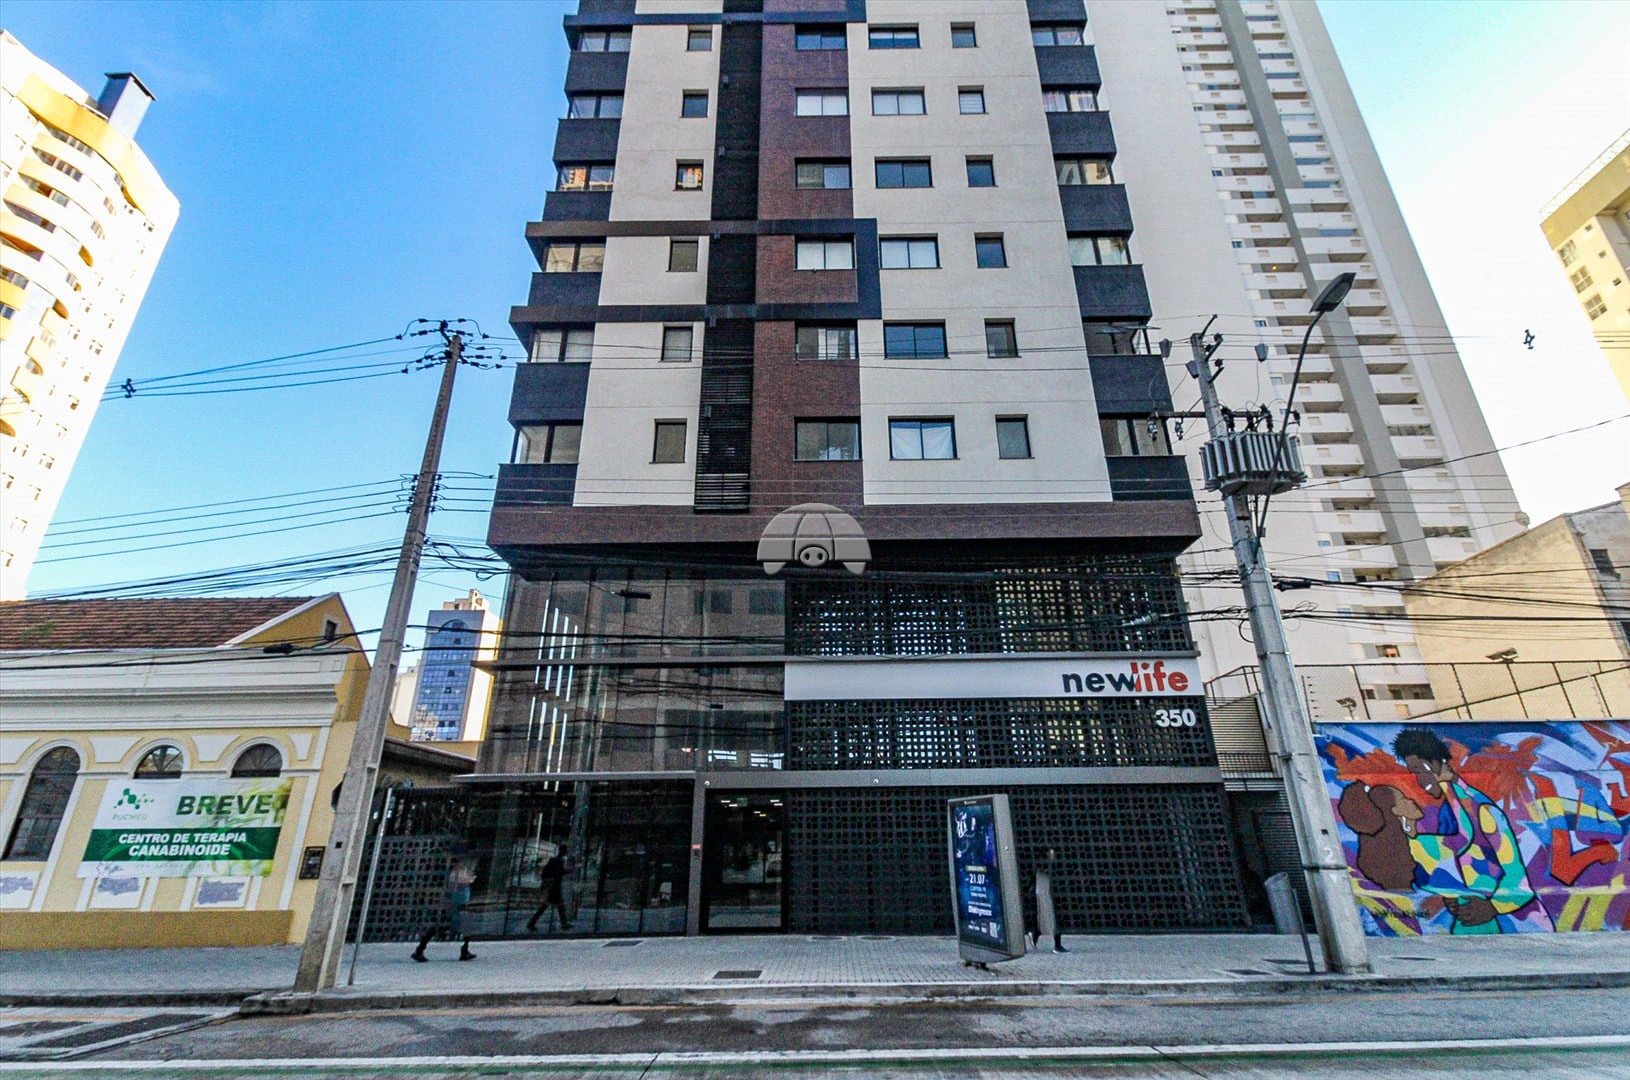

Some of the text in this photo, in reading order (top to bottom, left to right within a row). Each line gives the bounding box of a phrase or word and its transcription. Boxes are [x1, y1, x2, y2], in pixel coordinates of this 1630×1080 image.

[1062, 660, 1189, 693] newlife
[1155, 708, 1197, 727] 350
[177, 795, 273, 815] BREVE
[118, 832, 246, 843] CENTRO DE TERAPIA
[128, 844, 231, 856] CANABINOIDE
